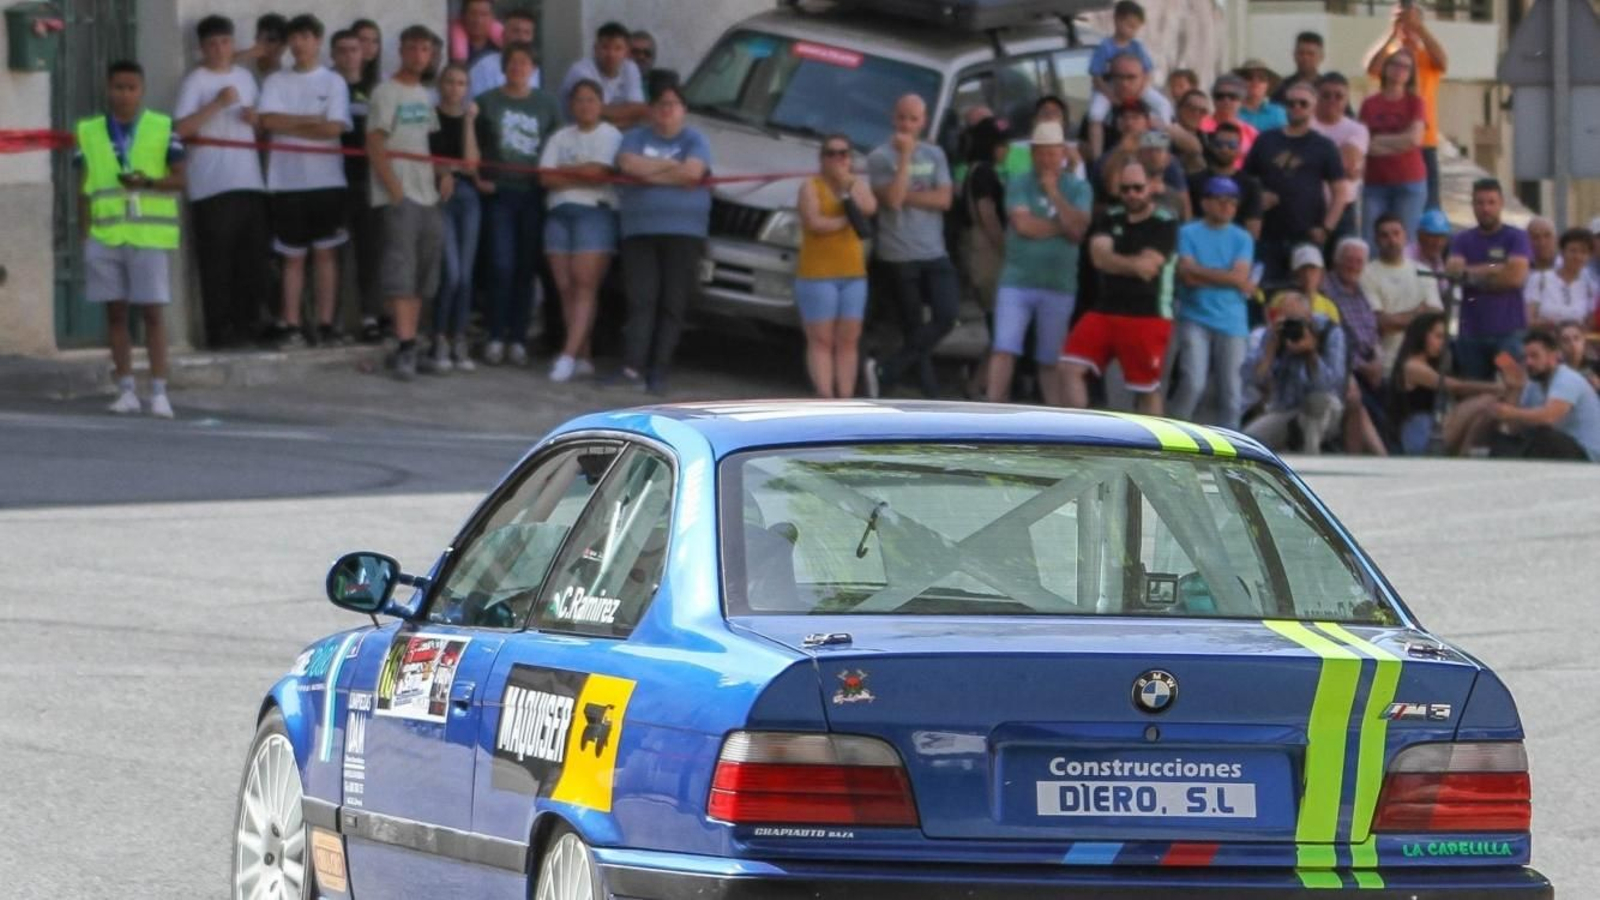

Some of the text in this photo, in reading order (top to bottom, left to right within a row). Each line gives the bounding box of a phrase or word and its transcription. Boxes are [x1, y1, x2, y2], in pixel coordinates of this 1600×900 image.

[497, 685, 575, 763] MAQUISER
[1049, 756, 1242, 778] Construcciones
[1186, 786, 1235, 814] S.L
[754, 827, 825, 838] CHAPIAUTO
[1402, 841, 1513, 857] LA CAPELILLA
